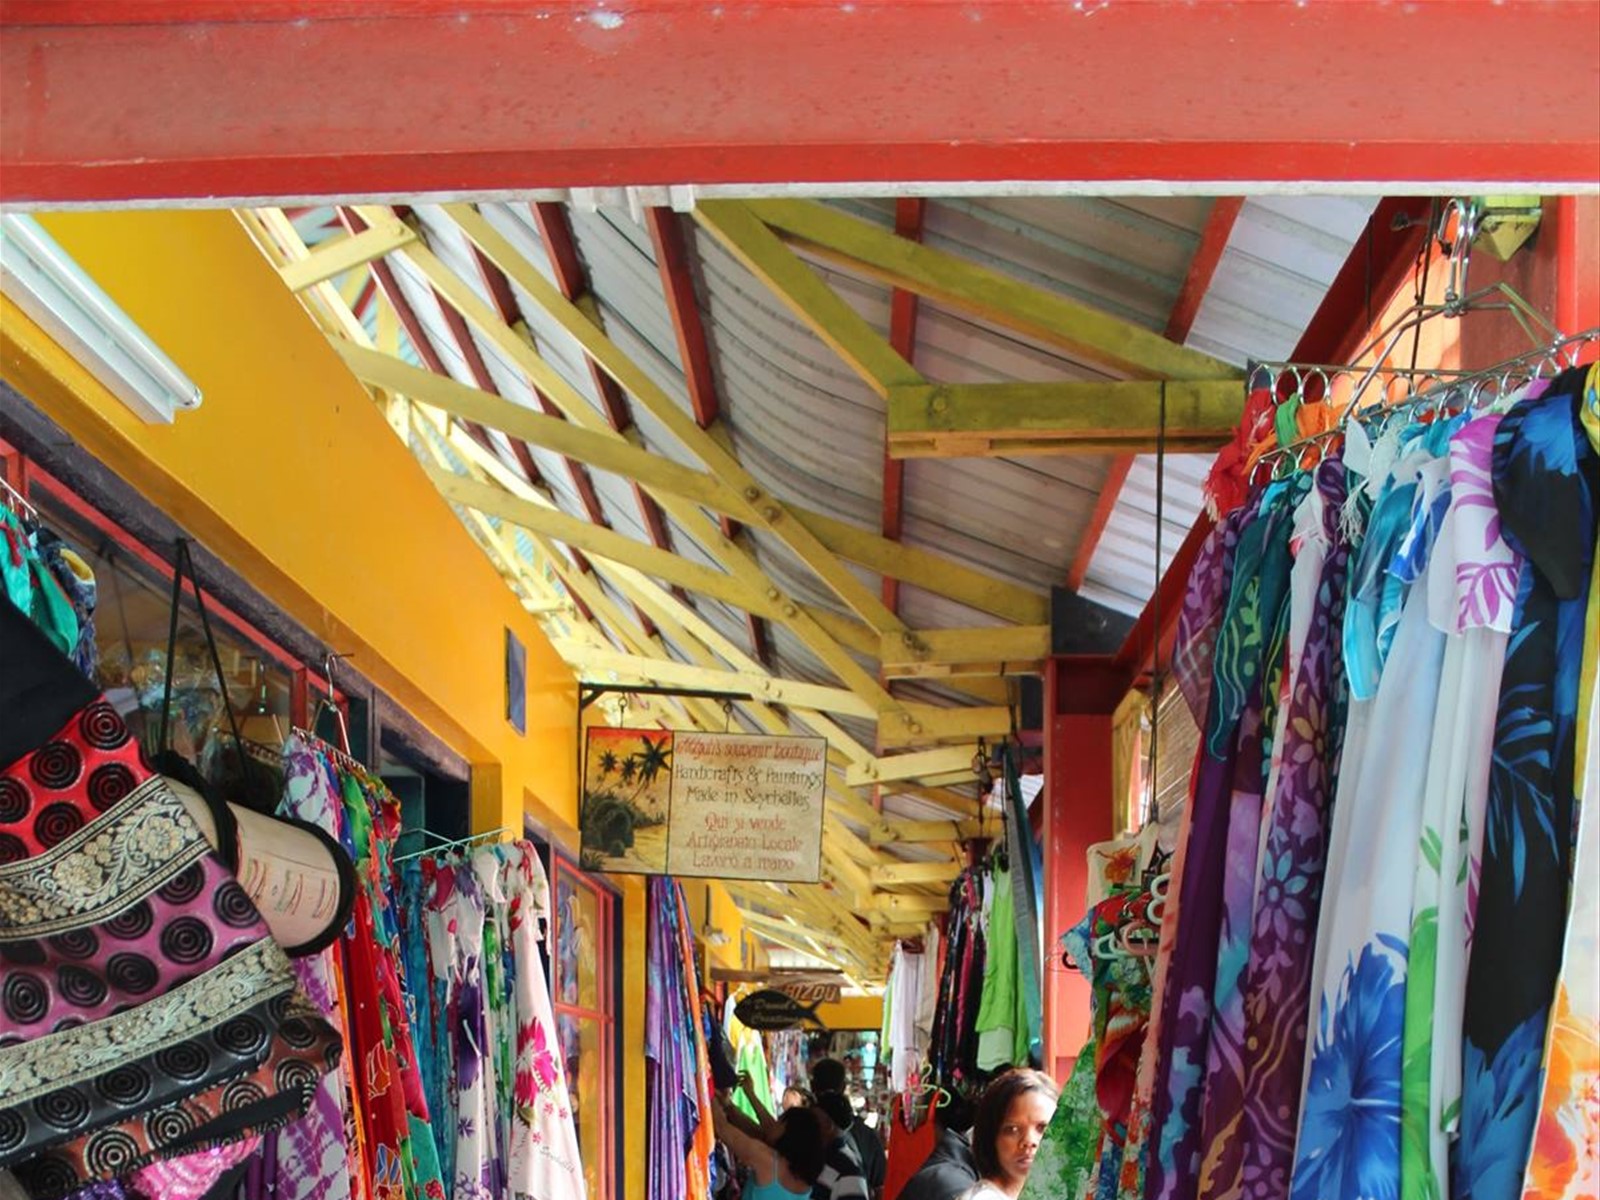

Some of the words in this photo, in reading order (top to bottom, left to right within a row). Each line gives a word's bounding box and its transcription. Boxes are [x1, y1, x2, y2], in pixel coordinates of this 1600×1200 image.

[746, 766, 762, 786] &
[766, 767, 822, 791] Paintings
[683, 785, 719, 805] Made
[725, 790, 738, 804] in
[743, 787, 810, 813] Seychelles
[761, 833, 804, 852] Locale
[743, 857, 752, 869] a
[758, 857, 796, 871] mano
